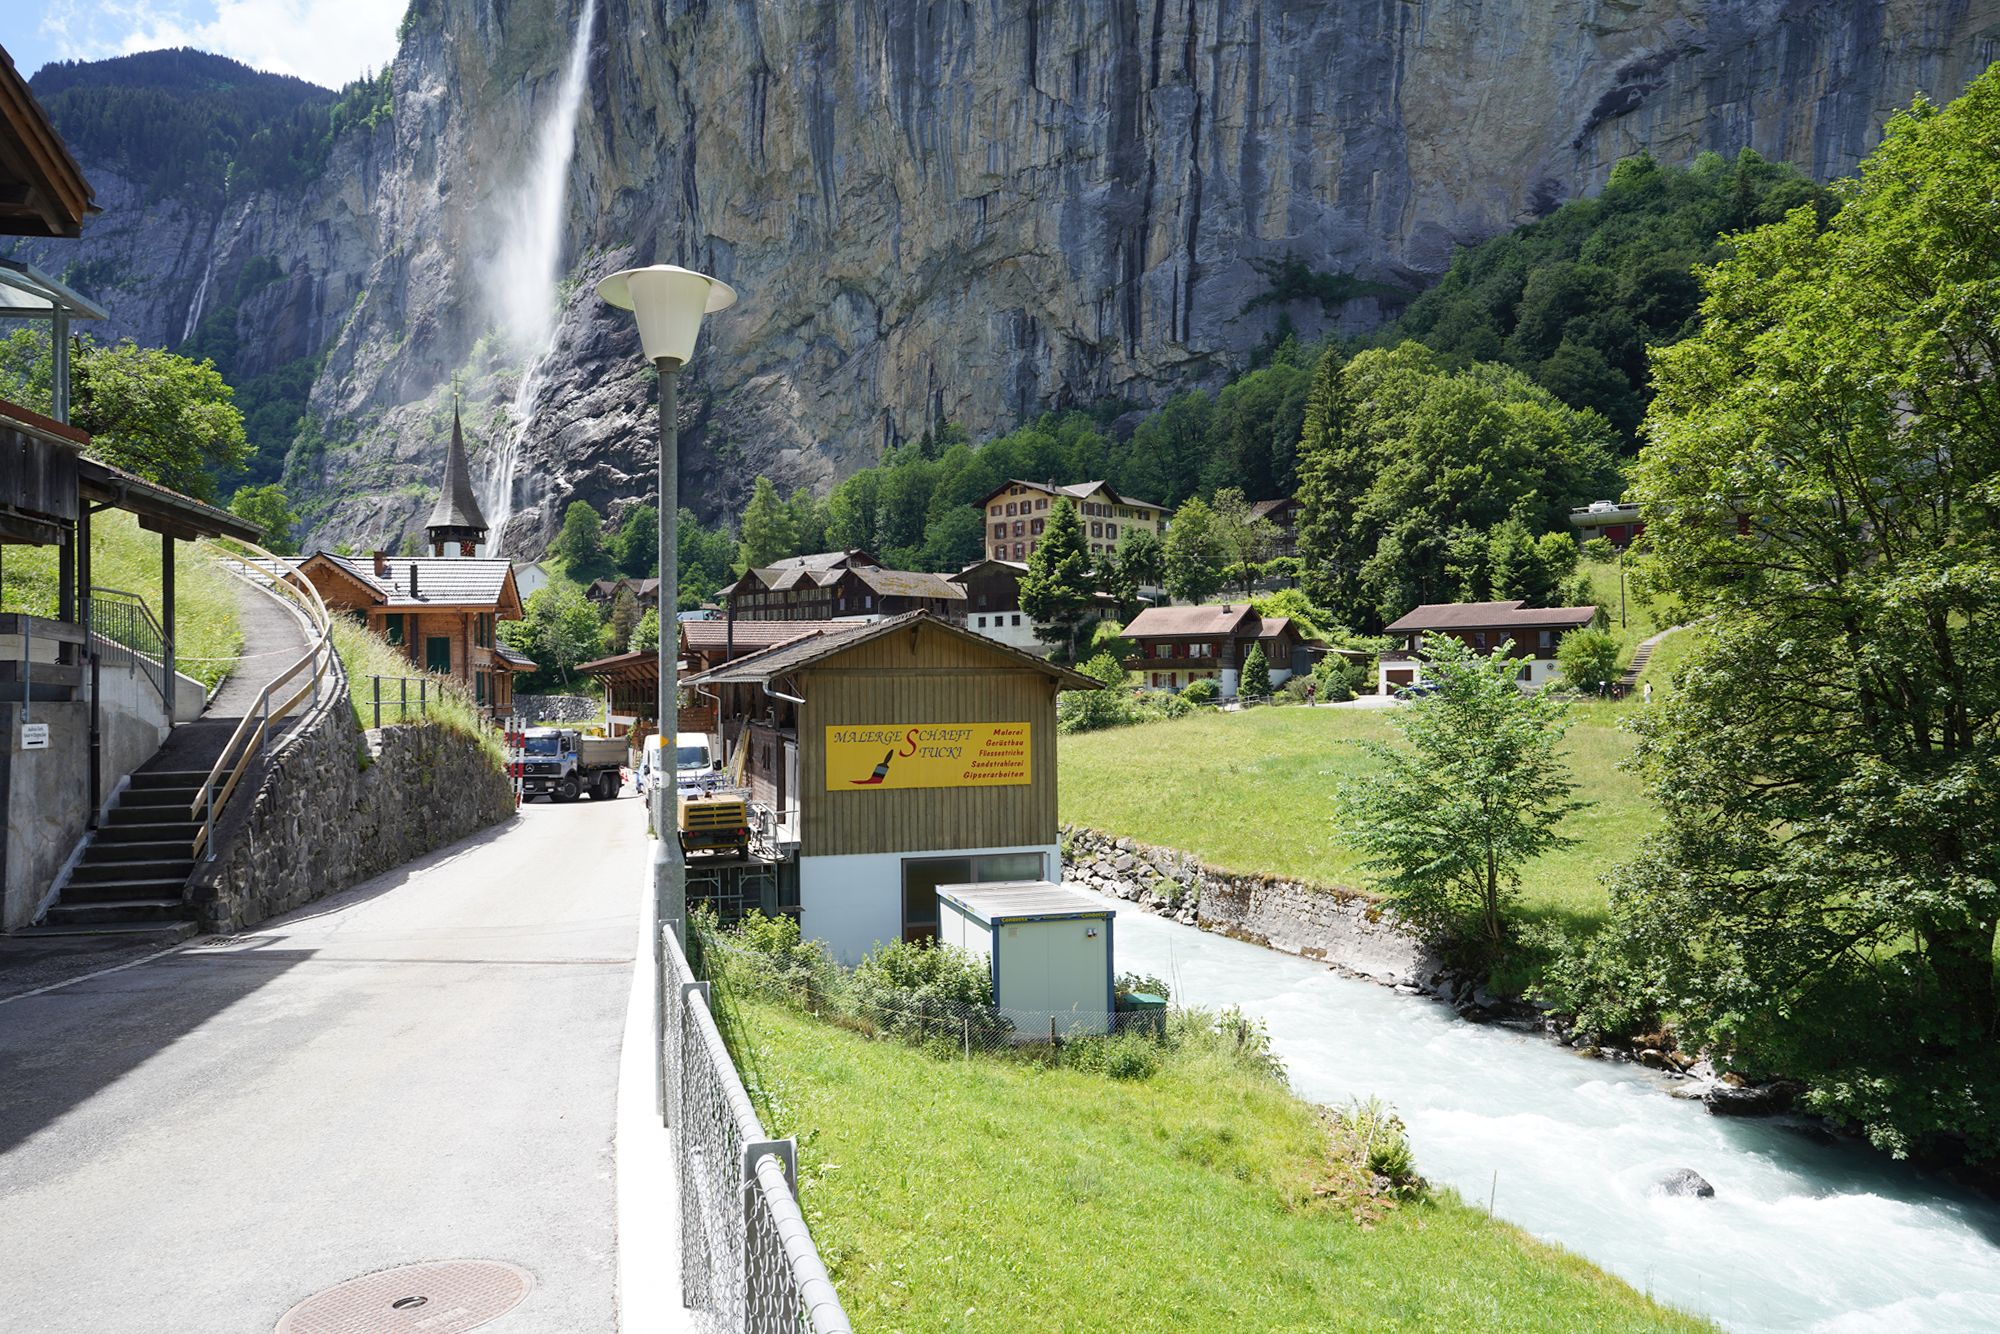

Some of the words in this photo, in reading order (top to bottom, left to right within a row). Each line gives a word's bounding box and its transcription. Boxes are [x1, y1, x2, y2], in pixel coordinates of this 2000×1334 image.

[985, 739, 1024, 747] Gerüstbau
[970, 760, 1024, 768] Sandstrahlerei
[963, 771, 1025, 780] Gipserarbeiten
